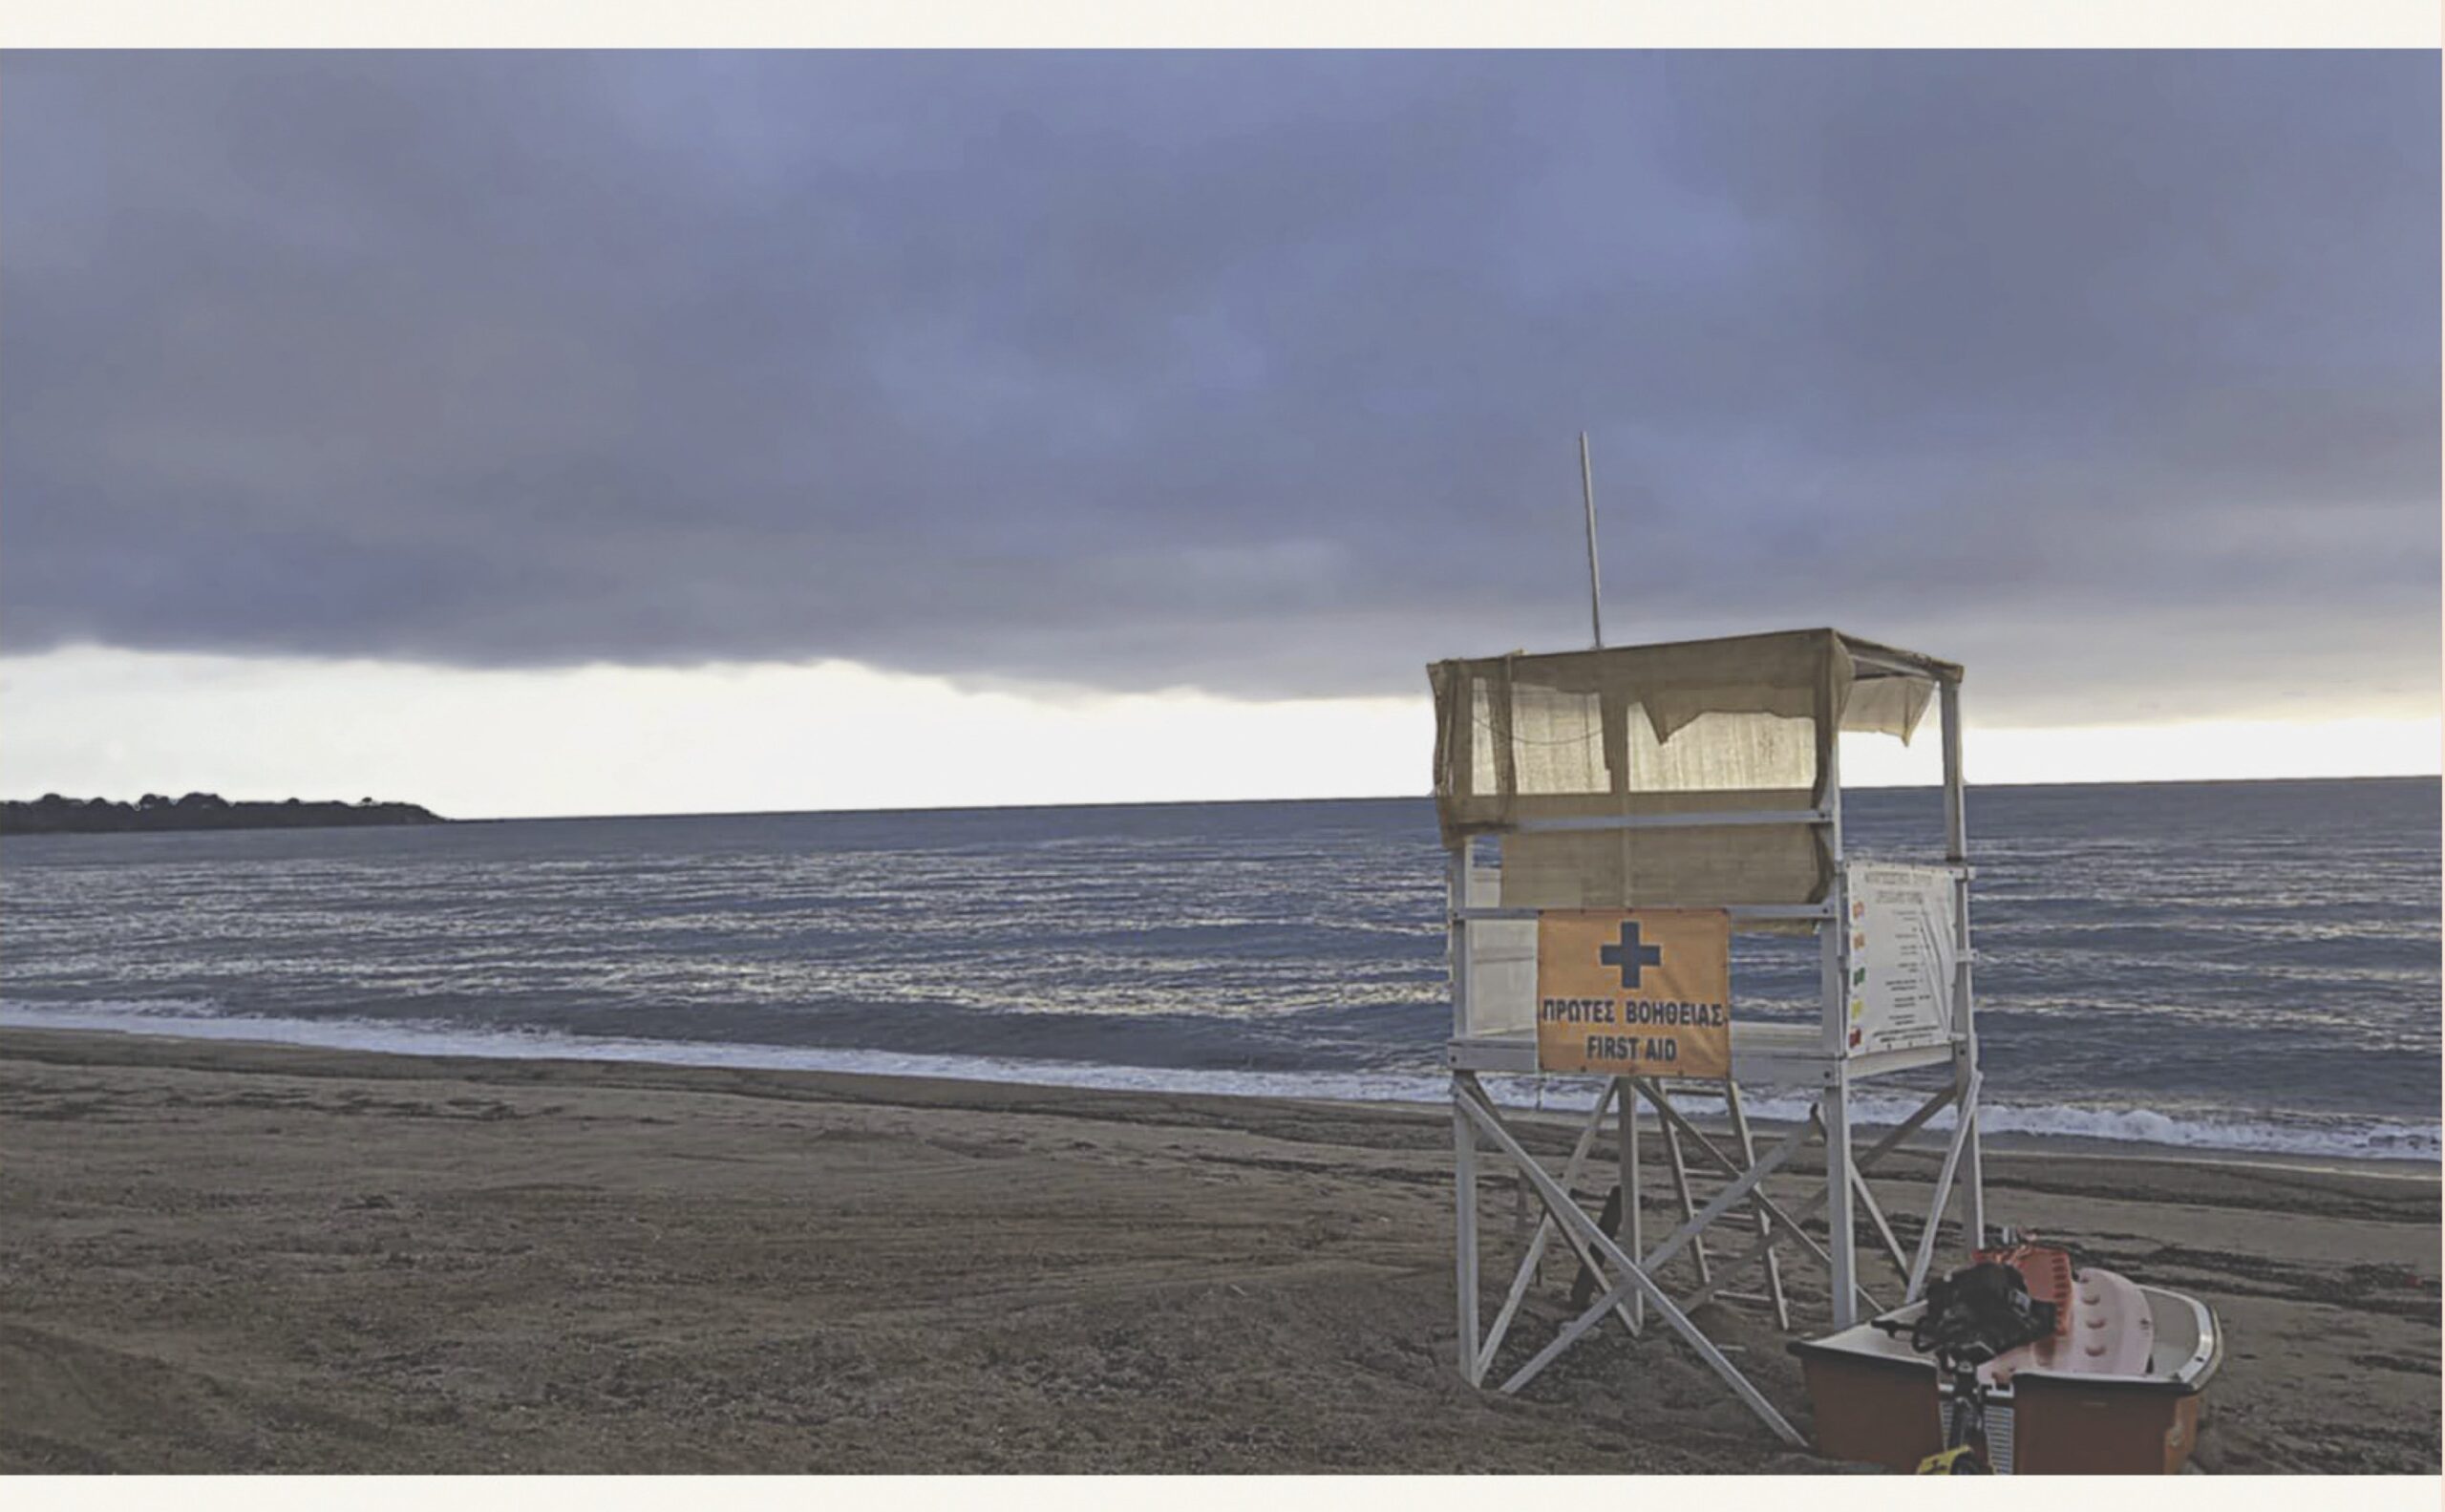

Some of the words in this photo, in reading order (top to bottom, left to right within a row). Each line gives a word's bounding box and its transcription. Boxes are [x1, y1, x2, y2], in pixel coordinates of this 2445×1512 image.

[1543, 1000, 1615, 1024] ΠΡΩΤΕΣ
[1626, 1001, 1723, 1027] ΒΟΗΘΕΙΑΣ
[1587, 1036, 1640, 1060] FIRST
[1646, 1038, 1677, 1061] AID
